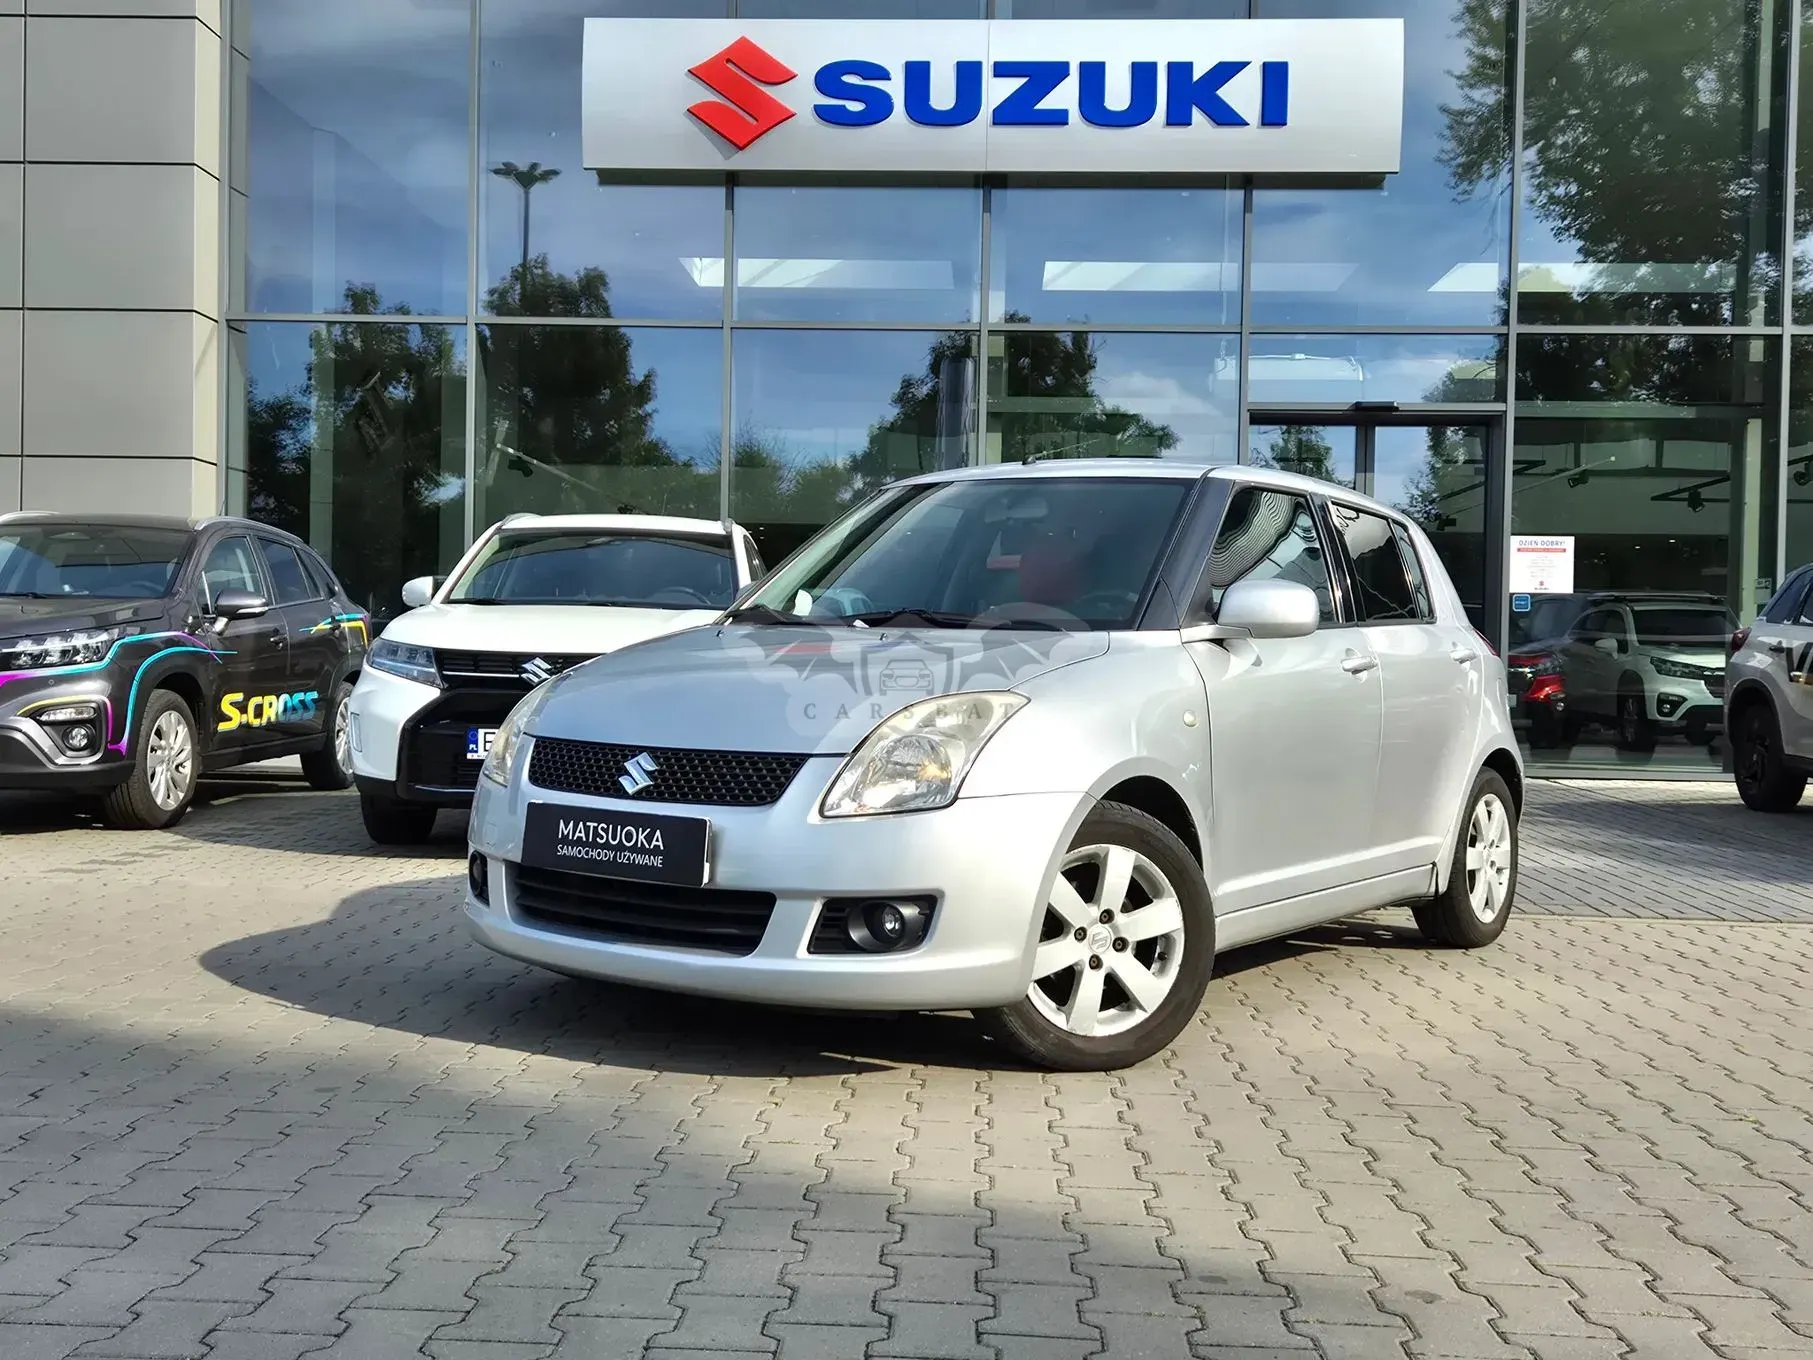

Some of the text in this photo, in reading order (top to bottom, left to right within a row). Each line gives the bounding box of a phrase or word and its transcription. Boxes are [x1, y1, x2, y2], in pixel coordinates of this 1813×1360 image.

[812, 59, 1289, 128] SUZUKI
[558, 819, 664, 850] MATSUOKA
[556, 844, 664, 868] SAMOCHODY UŻYWANE
